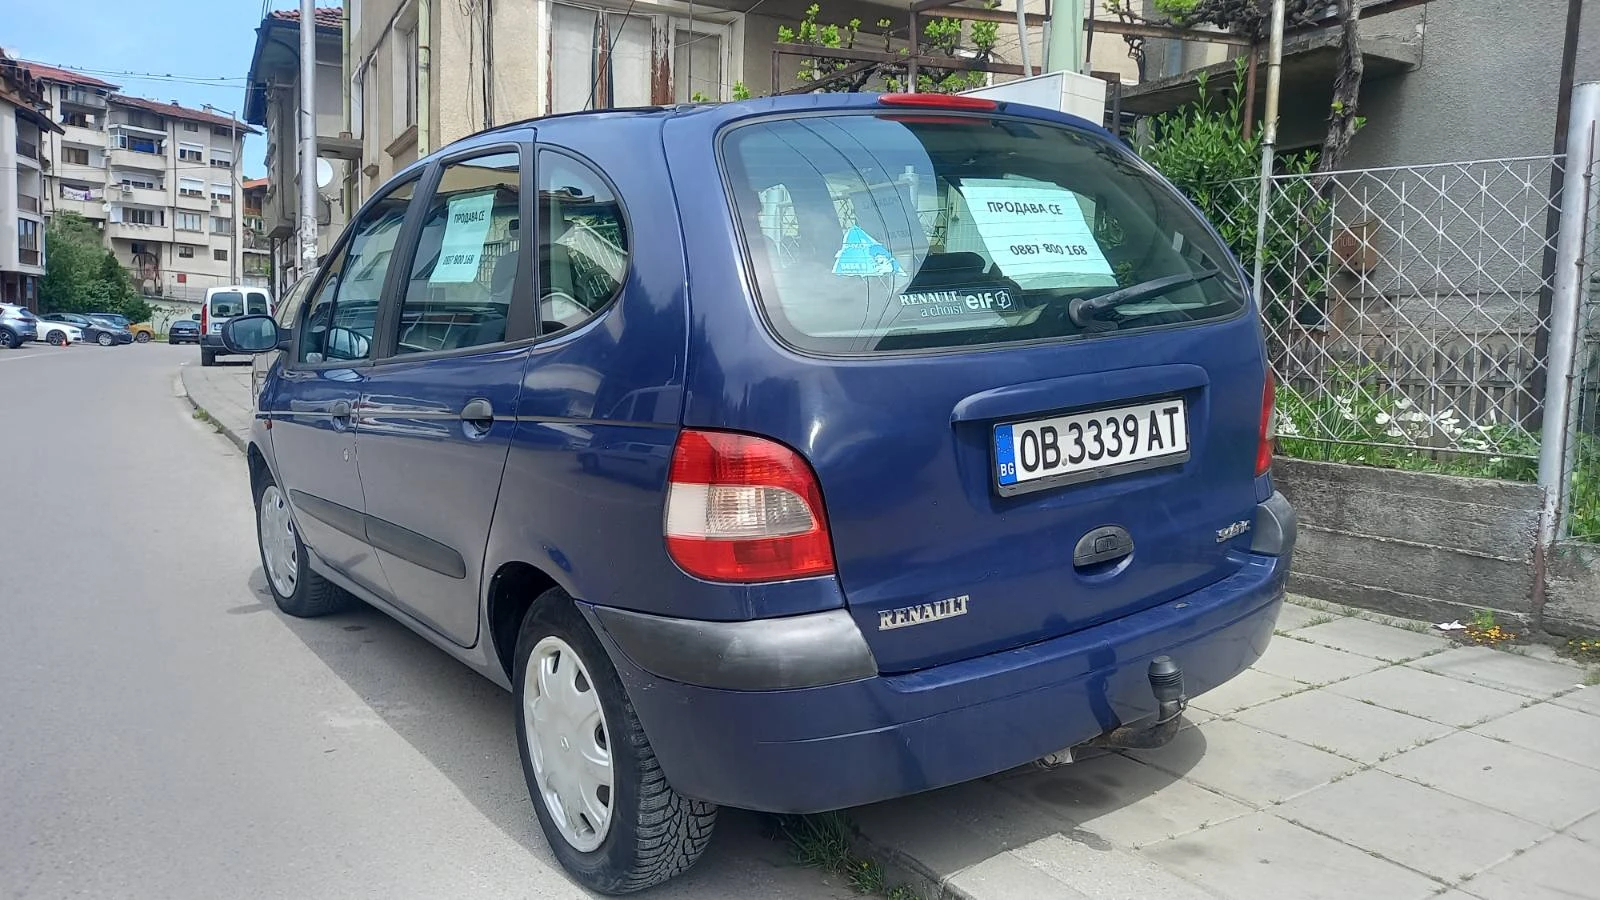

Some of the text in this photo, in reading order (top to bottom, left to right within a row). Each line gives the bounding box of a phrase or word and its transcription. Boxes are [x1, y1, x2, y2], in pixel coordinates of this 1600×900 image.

[987, 201, 1063, 215] ПРОДАВА СЕ
[454, 211, 478, 224] ПРОДАВА
[1009, 243, 1088, 256] 0887 800 168
[899, 290, 958, 306] RENAULT
[965, 292, 994, 310] elf
[921, 302, 964, 317] a choisi
[999, 463, 1015, 477] BG
[878, 594, 970, 631] RENAULT
